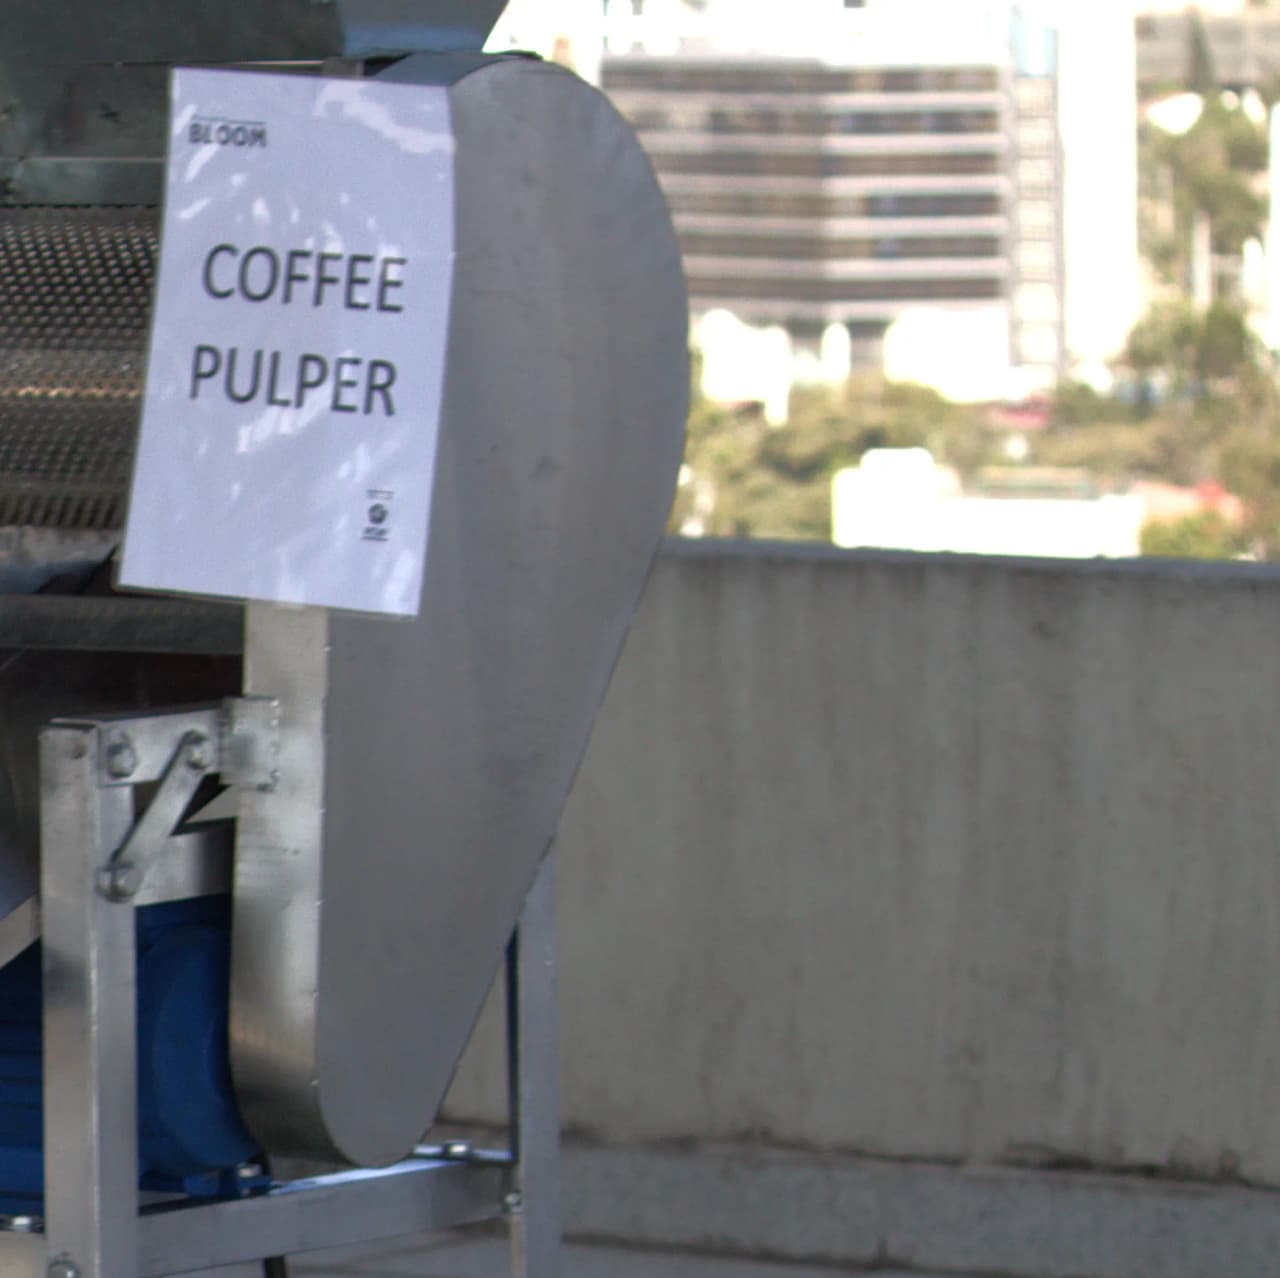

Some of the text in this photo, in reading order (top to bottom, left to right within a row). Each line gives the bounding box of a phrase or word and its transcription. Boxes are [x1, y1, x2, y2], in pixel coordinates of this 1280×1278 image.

[188, 122, 268, 147] BLOOM
[202, 242, 407, 314] COFFEE
[190, 344, 398, 416] PULPER
